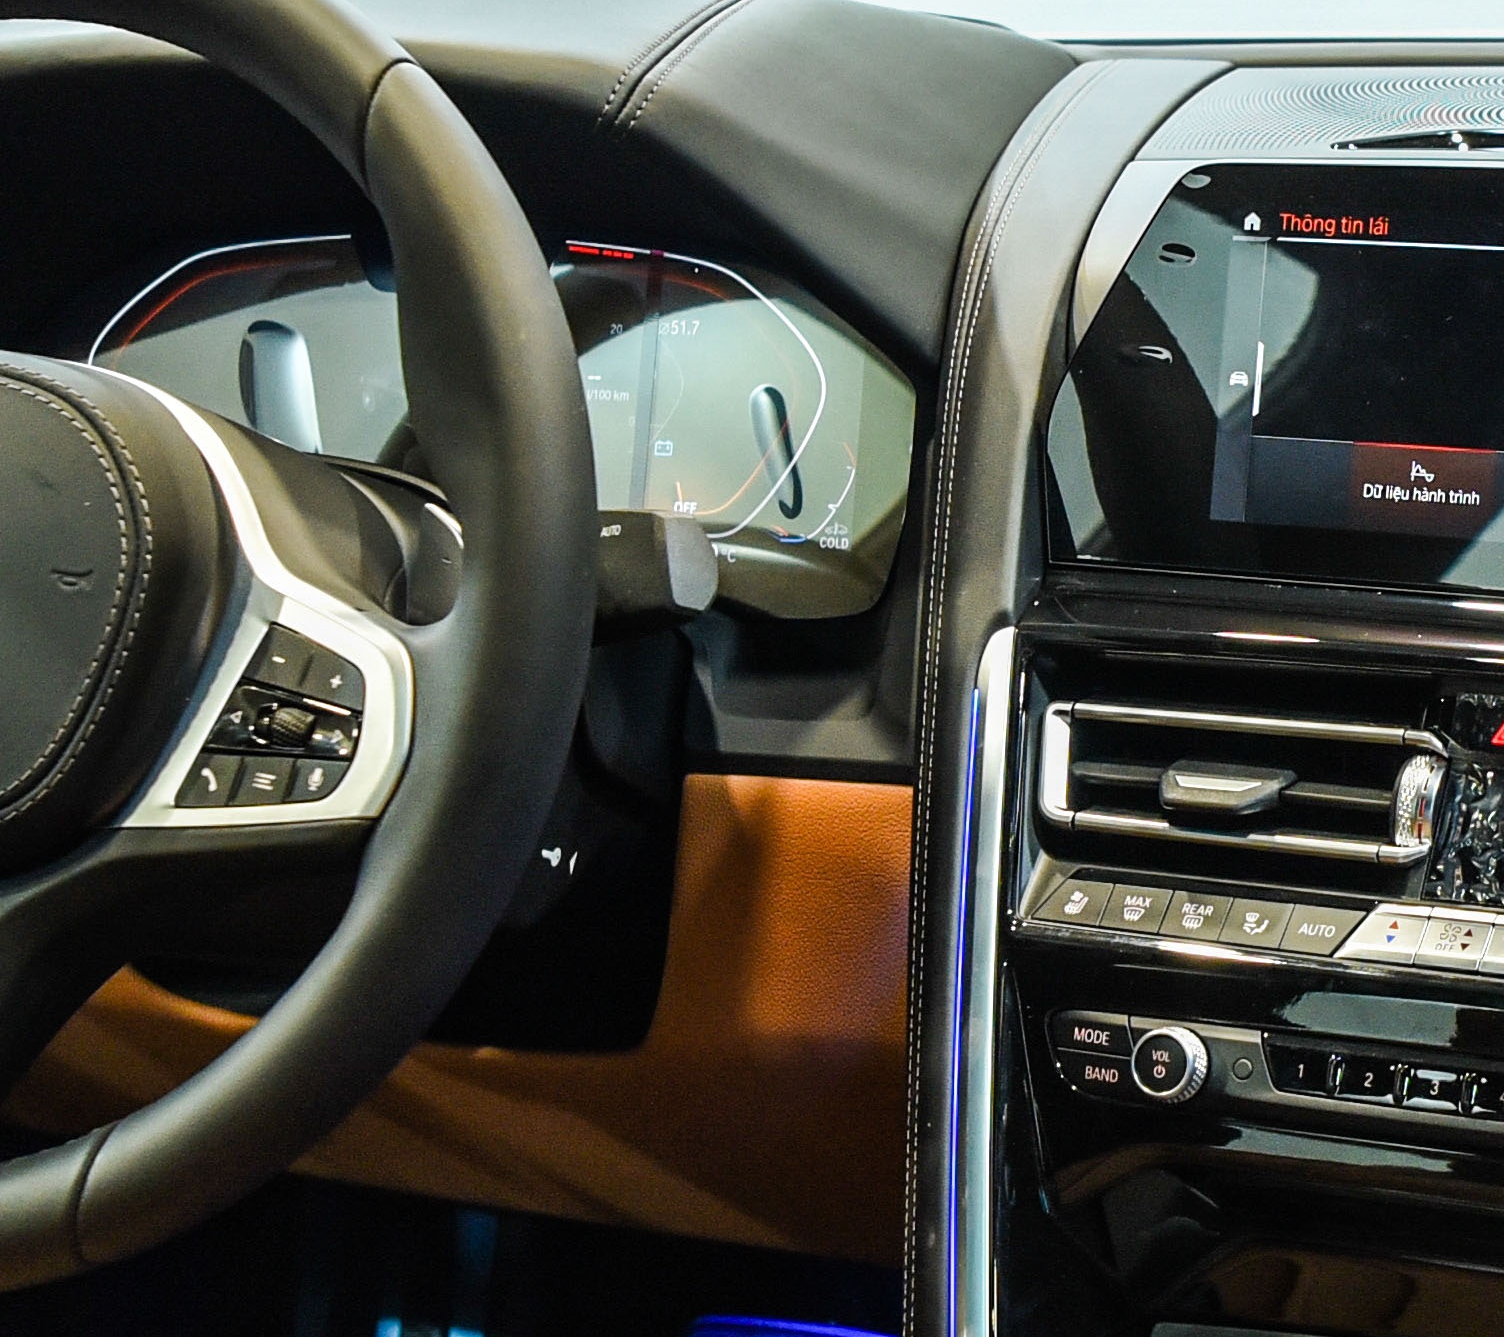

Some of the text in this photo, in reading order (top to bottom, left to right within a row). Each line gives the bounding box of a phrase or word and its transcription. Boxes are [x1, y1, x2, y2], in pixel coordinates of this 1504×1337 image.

[1279, 212, 1390, 237] Thông tin lái
[613, 390, 630, 402] km
[1385, 486, 1410, 503] liệu
[1412, 489, 1446, 505] hành
[1449, 489, 1481, 506] trình
[600, 524, 622, 538] AUTO
[819, 536, 849, 551] COLD
[1124, 895, 1152, 909] MAX
[1181, 903, 1214, 917] REAR
[1298, 922, 1336, 939] AUTO
[1073, 1026, 1111, 1046] MODE
[1151, 1049, 1171, 1063] VOL
[1084, 1065, 1119, 1083] BAND
[1298, 1063, 1305, 1079] 1
[1364, 1072, 1374, 1088] 2
[1429, 1080, 1439, 1096] 3
